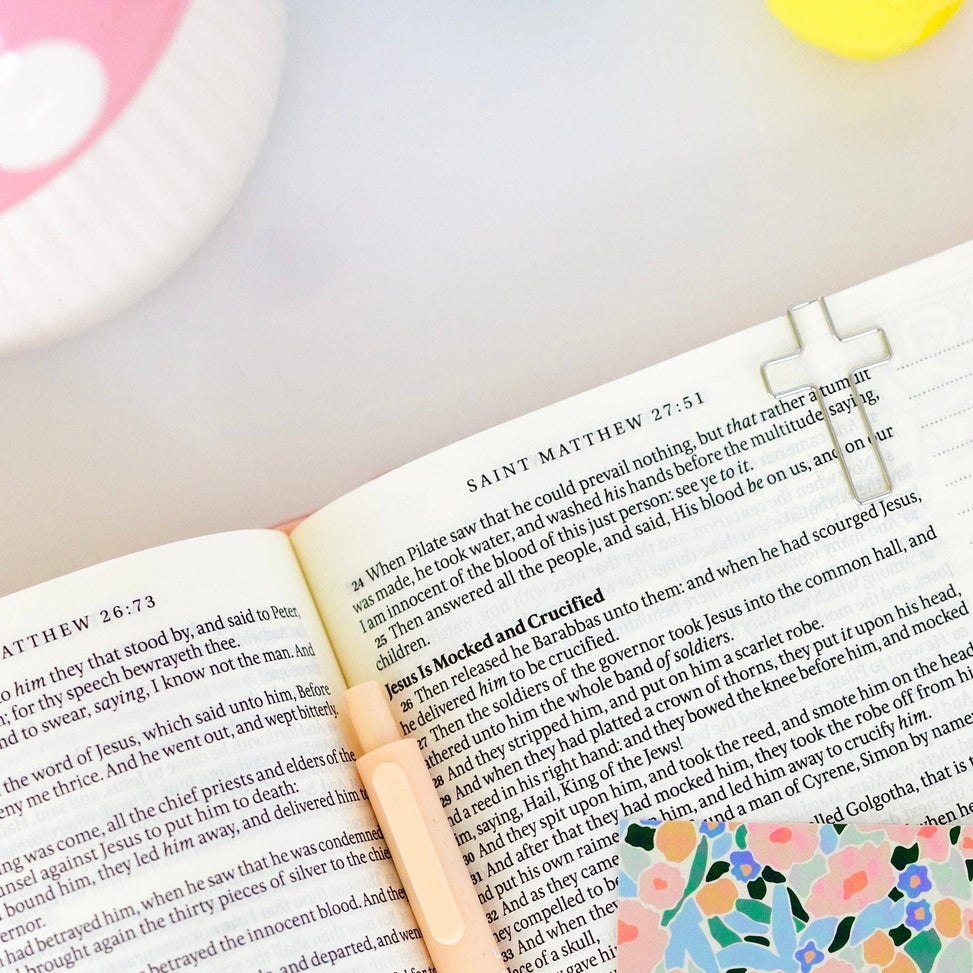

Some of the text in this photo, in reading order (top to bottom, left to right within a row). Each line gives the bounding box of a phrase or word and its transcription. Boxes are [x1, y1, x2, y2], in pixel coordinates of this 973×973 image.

[466, 392, 704, 493] SAINT MATTHEW 27:51
[359, 460, 754, 634] I am innocent of the blood of this just person: see ye to it.
[401, 492, 922, 713] 26 Then released he Barabbas unto them: and when he had scourged Jesus,
[2, 595, 156, 660] ATTHEW 26:73
[376, 637, 431, 672] children.
[385, 587, 606, 702] Jesus Is Mocked and Crucified
[400, 627, 620, 736] he delivered him to be crucified.
[3, 682, 331, 794] the word of Jesus, which said unto him, Before
[463, 852, 476, 867] 30
[478, 832, 506, 859] And
[506, 821, 537, 844] they
[539, 807, 568, 831] spit
[568, 791, 610, 817] upon
[608, 778, 648, 799] him,
[648, 759, 678, 784] and
[678, 747, 715, 771] took
[714, 739, 741, 757] the
[741, 721, 781, 747] reed,
[781, 707, 811, 731] and
[812, 694, 858, 720] smote
[856, 681, 891, 702] him
[891, 672, 913, 688] on
[913, 661, 939, 679] the
[0, 780, 299, 898] unsel against Jesus to put him to death:
[486, 854, 619, 924] 32 And as they came
